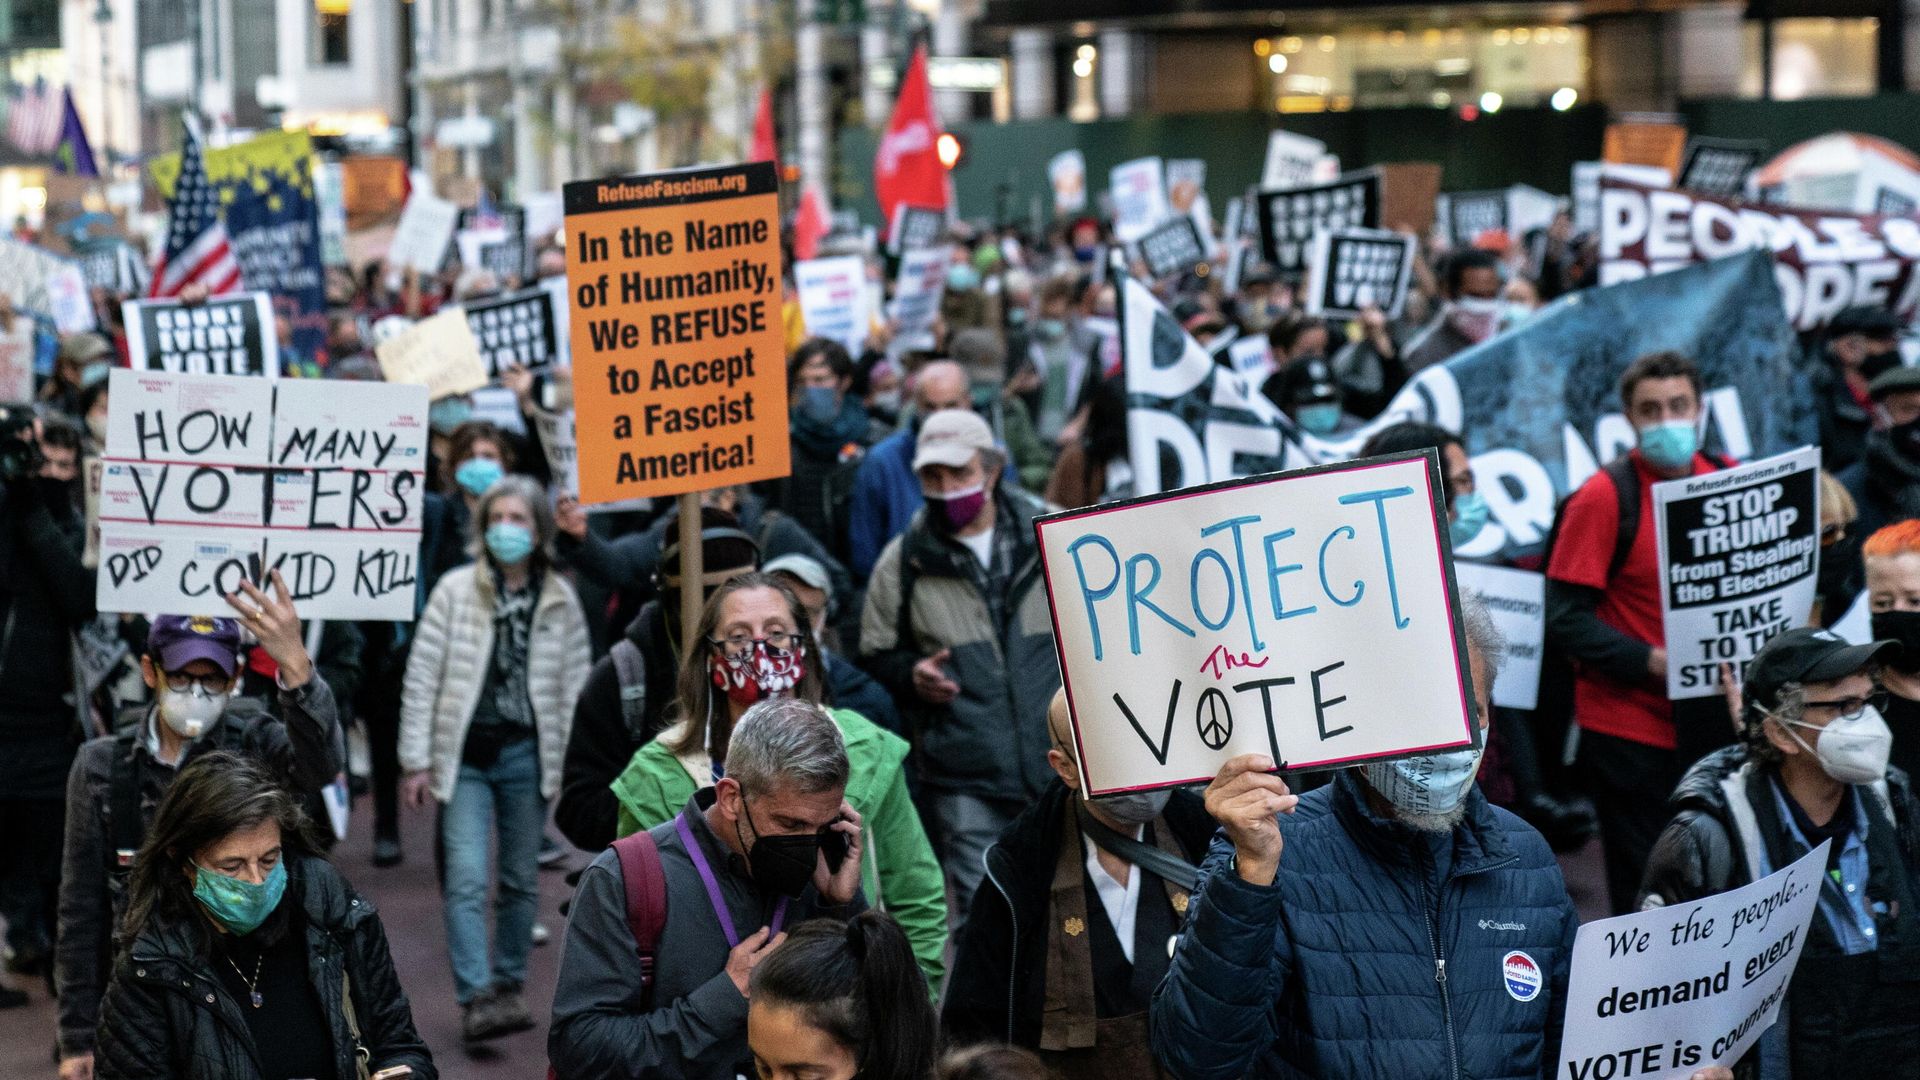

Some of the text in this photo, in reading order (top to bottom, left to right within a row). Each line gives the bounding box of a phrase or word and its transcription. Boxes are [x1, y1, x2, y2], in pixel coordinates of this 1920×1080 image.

[597, 174, 747, 204] RefuseFascism.org
[578, 218, 769, 264] In the Name
[577, 274, 609, 309] of
[620, 258, 775, 305] Humanity,
[588, 318, 640, 353] We
[650, 300, 767, 346] REFUSE
[606, 347, 755, 395] to Accept
[134, 410, 398, 468] HOW MANY
[612, 391, 755, 440] a Fascist
[615, 434, 755, 485] America!
[1686, 460, 1797, 495] RefuseFascism.org
[129, 463, 416, 531] VOTERS
[1702, 482, 1784, 527] STOP
[1687, 506, 1799, 558] TRUMP
[106, 545, 417, 601] DID COVID KILL
[1067, 486, 1414, 662] PROTECT
[1671, 534, 1815, 584] from Stealing
[1675, 551, 1811, 604] the Election!
[1699, 616, 1792, 660] TO THE
[1712, 596, 1783, 634] TAKE
[1200, 644, 1269, 681] The
[1112, 661, 1354, 770] VOTE
[1487, 919, 1527, 931] Columbia
[1604, 869, 1809, 960] We the people...
[1596, 924, 1800, 1019] demand every
[1568, 1043, 1664, 1080] VOTE
[1672, 1039, 1703, 1069] is
